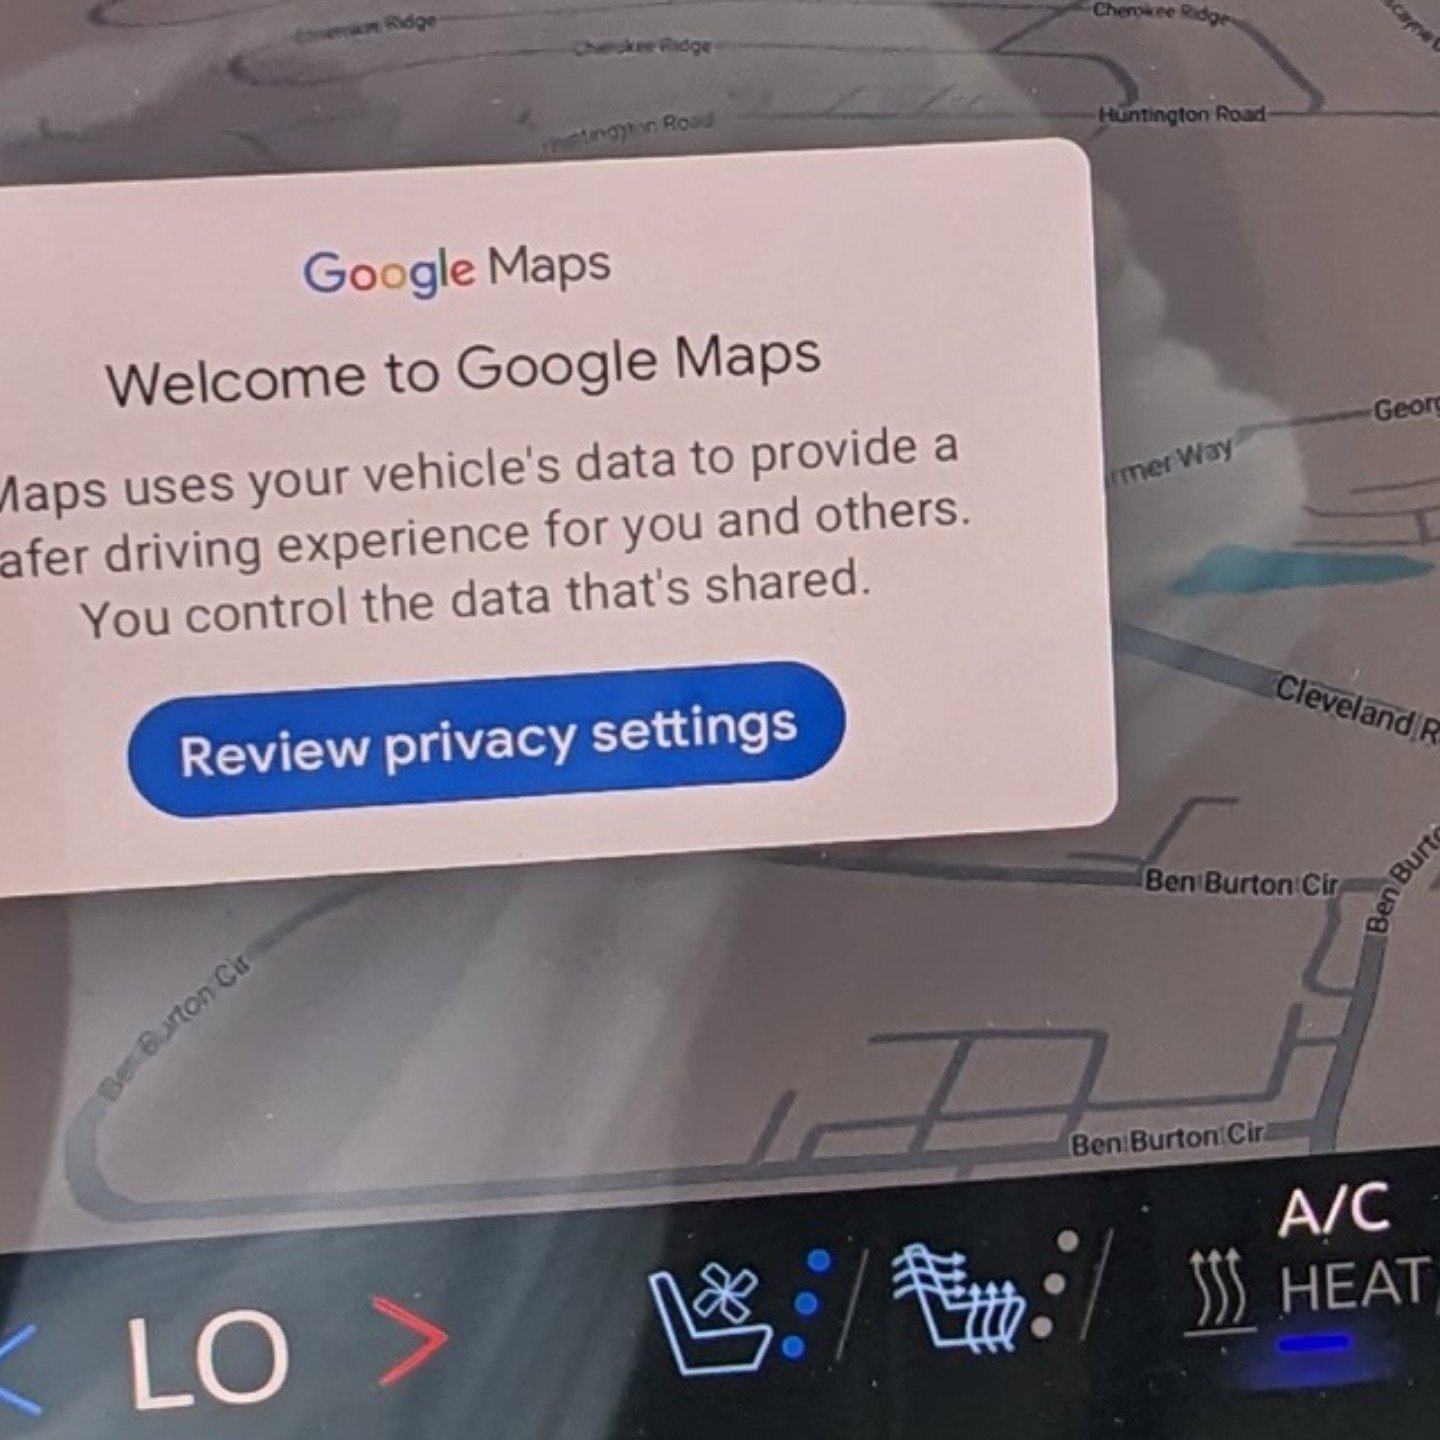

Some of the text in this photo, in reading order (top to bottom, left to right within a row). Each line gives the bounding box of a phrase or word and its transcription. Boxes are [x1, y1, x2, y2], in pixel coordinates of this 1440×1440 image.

[1179, 2, 1231, 28] Ridge
[1098, 103, 1267, 129] Huntington Road
[303, 244, 611, 300] Google Maps
[105, 333, 823, 408] Welcome to Google Maps
[124, 469, 235, 508] uses
[248, 464, 350, 510] your
[363, 445, 561, 494] vehicle's
[575, 441, 677, 484] data
[689, 438, 734, 476] to
[750, 427, 918, 491] provide
[932, 433, 960, 463] a
[1175, 437, 1233, 469] Way
[104, 530, 262, 578] driving
[277, 518, 531, 572] experience
[544, 506, 611, 550] for
[622, 508, 703, 553] you
[717, 495, 800, 542] and
[816, 489, 971, 533] others.
[80, 556, 872, 643] You control the data that's shared.
[1275, 672, 1418, 739] Cleveland
[178, 699, 799, 780] Review privacy settings
[1144, 868, 1340, 899] Ben Burton Cir
[1364, 882, 1401, 936] Ben
[98, 1048, 140, 1104] Ben
[212, 952, 252, 994] Cir
[1070, 1120, 1267, 1158] Ben Burton Cir
[1277, 1180, 1392, 1240] A/C
[1280, 1255, 1434, 1313] HEAT
[128, 1307, 291, 1413] LO
